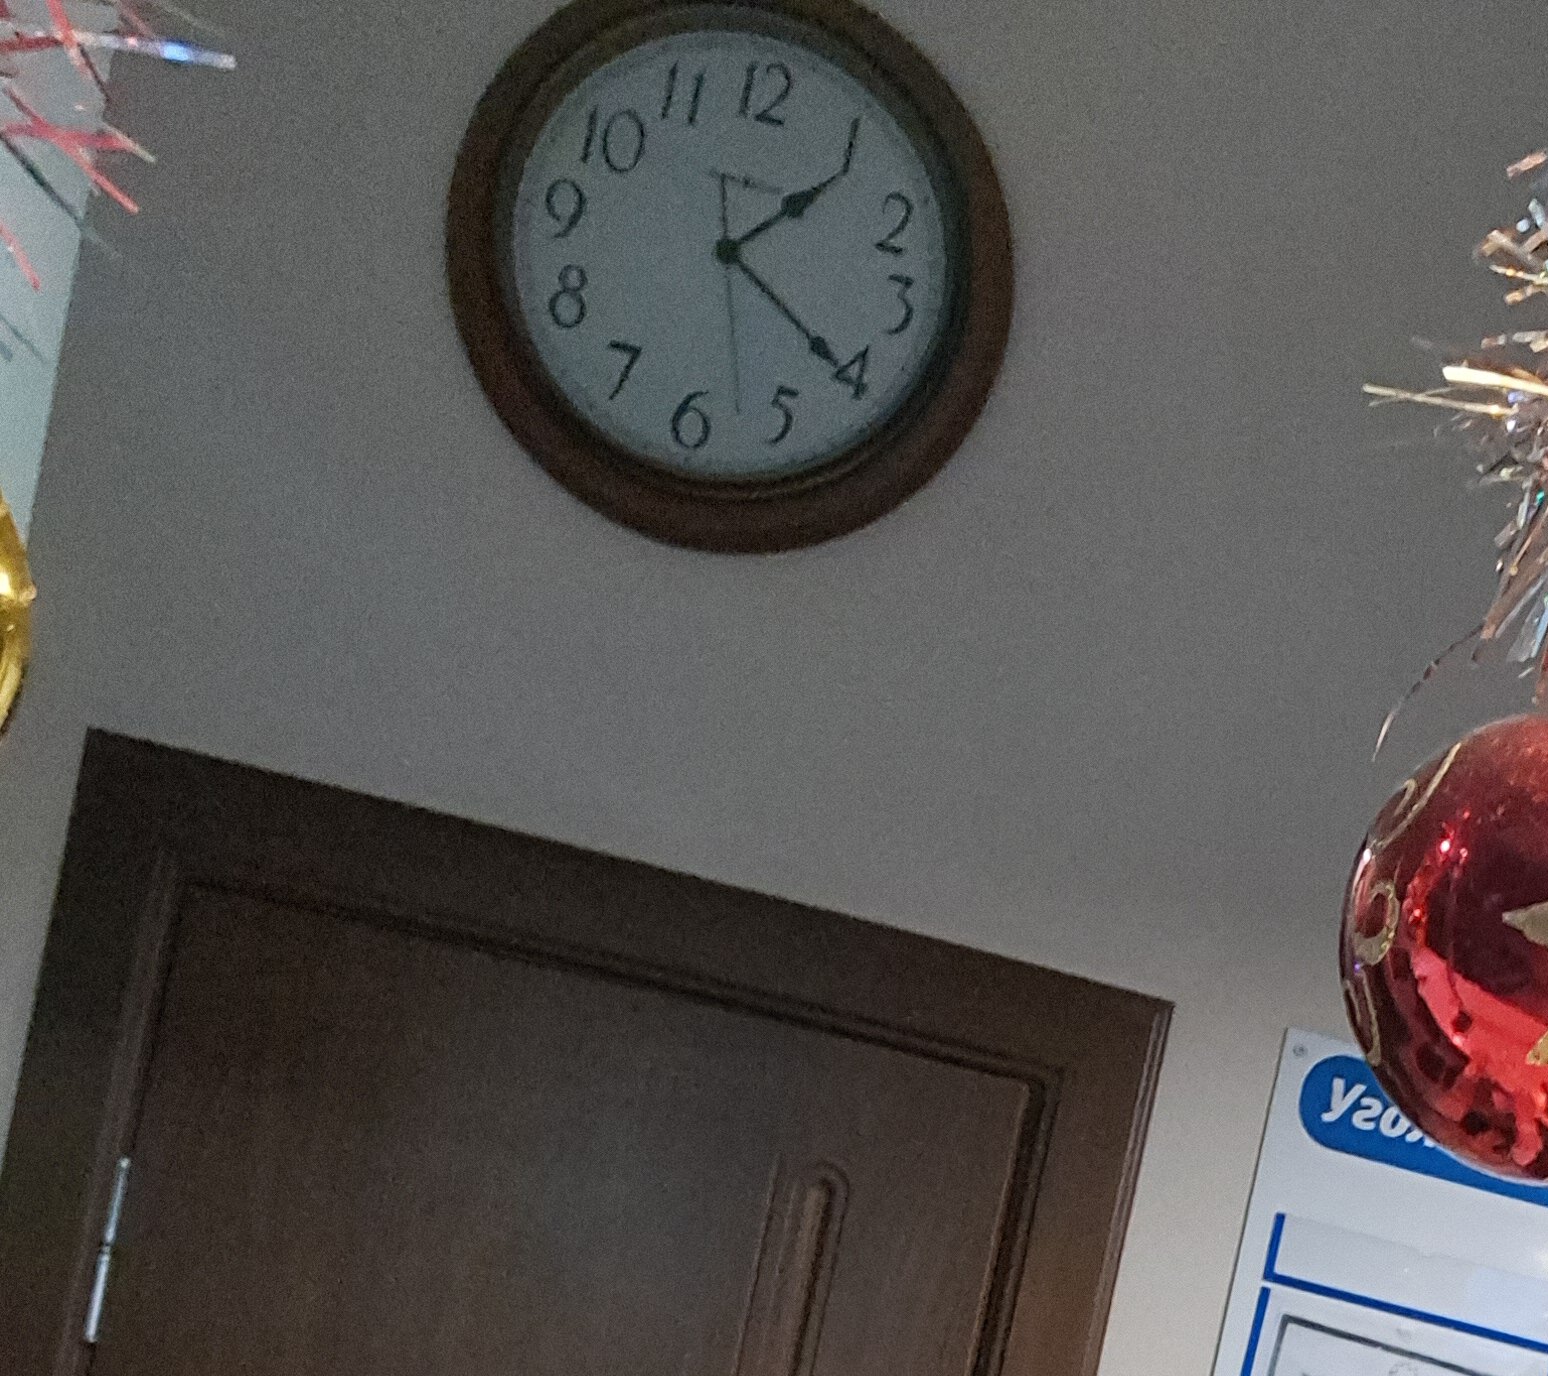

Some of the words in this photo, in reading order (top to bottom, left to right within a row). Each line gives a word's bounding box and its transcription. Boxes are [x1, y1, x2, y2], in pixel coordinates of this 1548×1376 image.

[661, 60, 702, 126] 11
[738, 62, 792, 126] 12
[580, 104, 645, 173] 10
[545, 178, 586, 238] 9
[876, 191, 914, 255] 2
[548, 264, 587, 328] 8
[886, 273, 914, 335] 3
[608, 339, 642, 400] 7
[834, 344, 870, 400] 4
[670, 390, 711, 449] 6
[765, 385, 799, 445] 5
[1321, 1076, 1437, 1149] Уго
